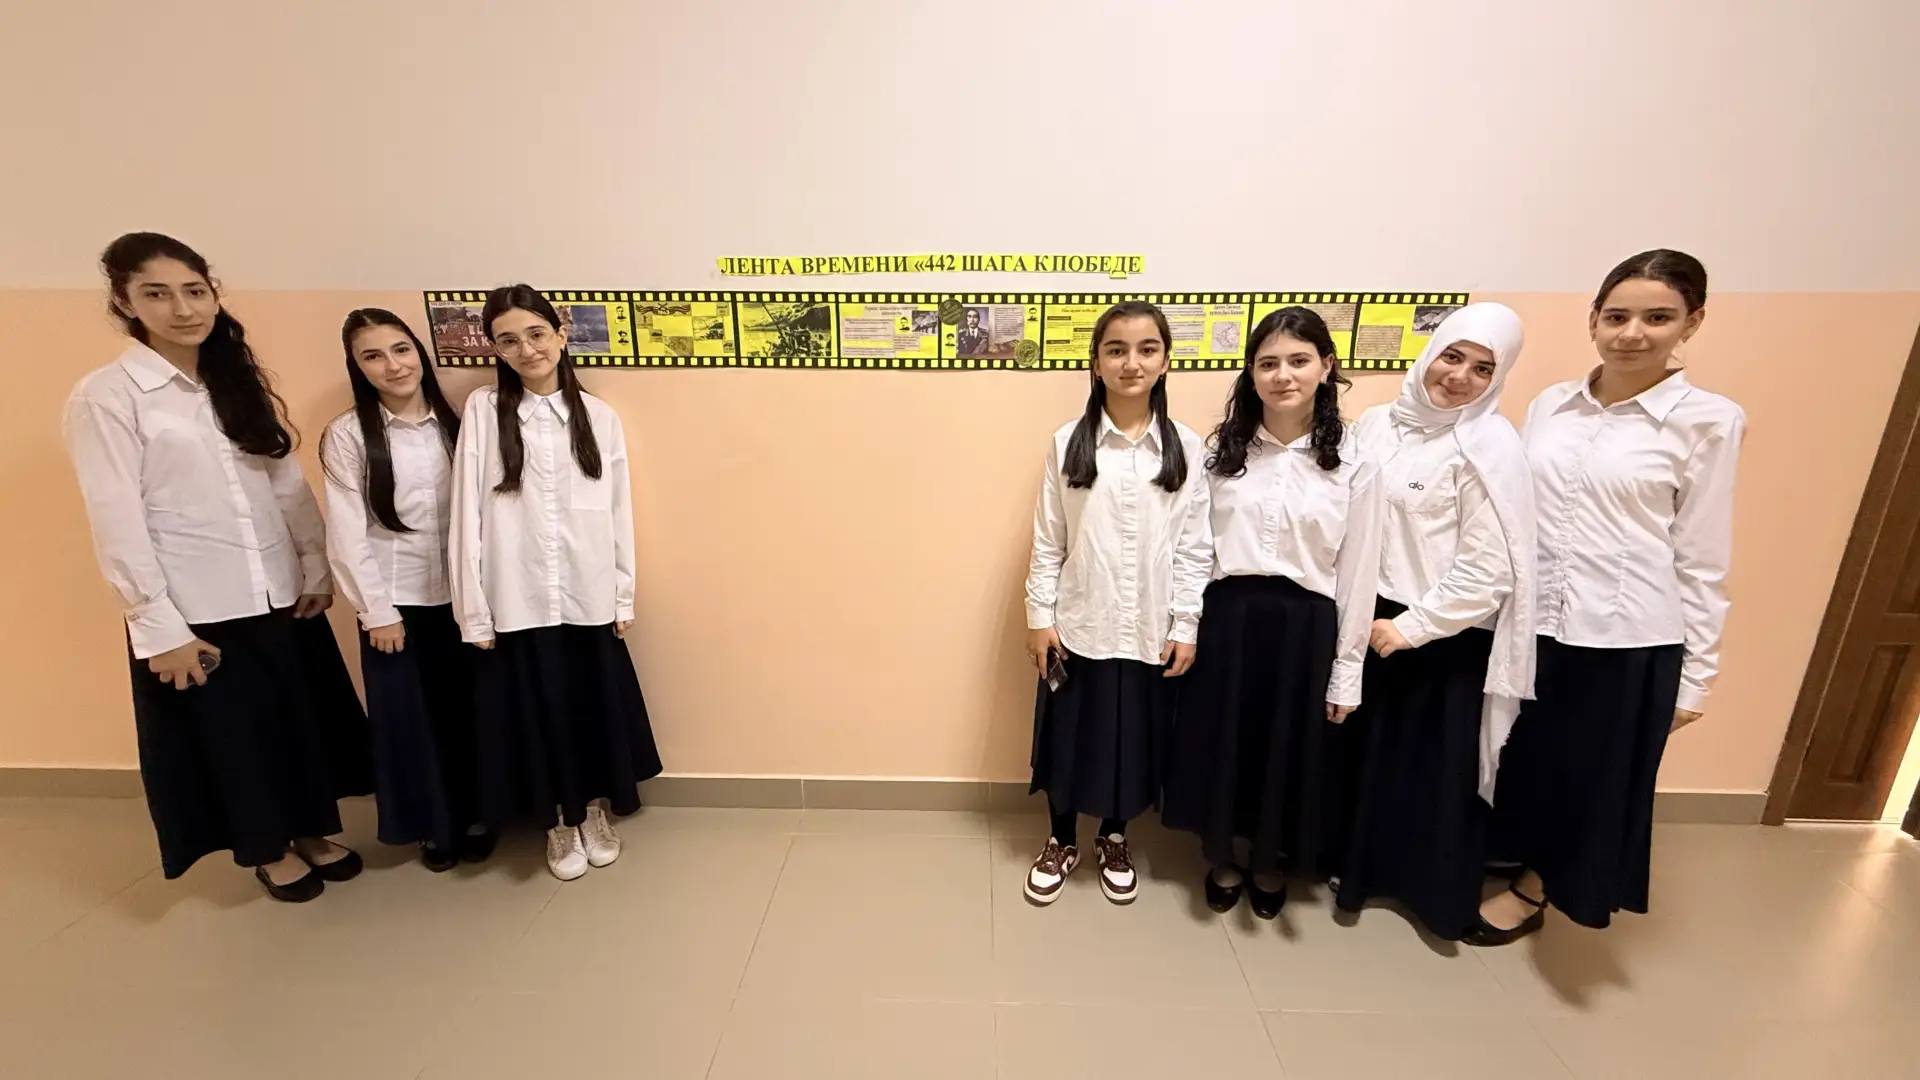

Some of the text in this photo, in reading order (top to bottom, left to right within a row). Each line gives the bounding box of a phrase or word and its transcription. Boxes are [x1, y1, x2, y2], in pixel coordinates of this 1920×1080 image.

[720, 257, 795, 275] ЛЕНТА
[800, 255, 908, 273] ВРЕМЕНИ
[914, 254, 956, 272] «442
[962, 255, 1028, 272] ШАГА
